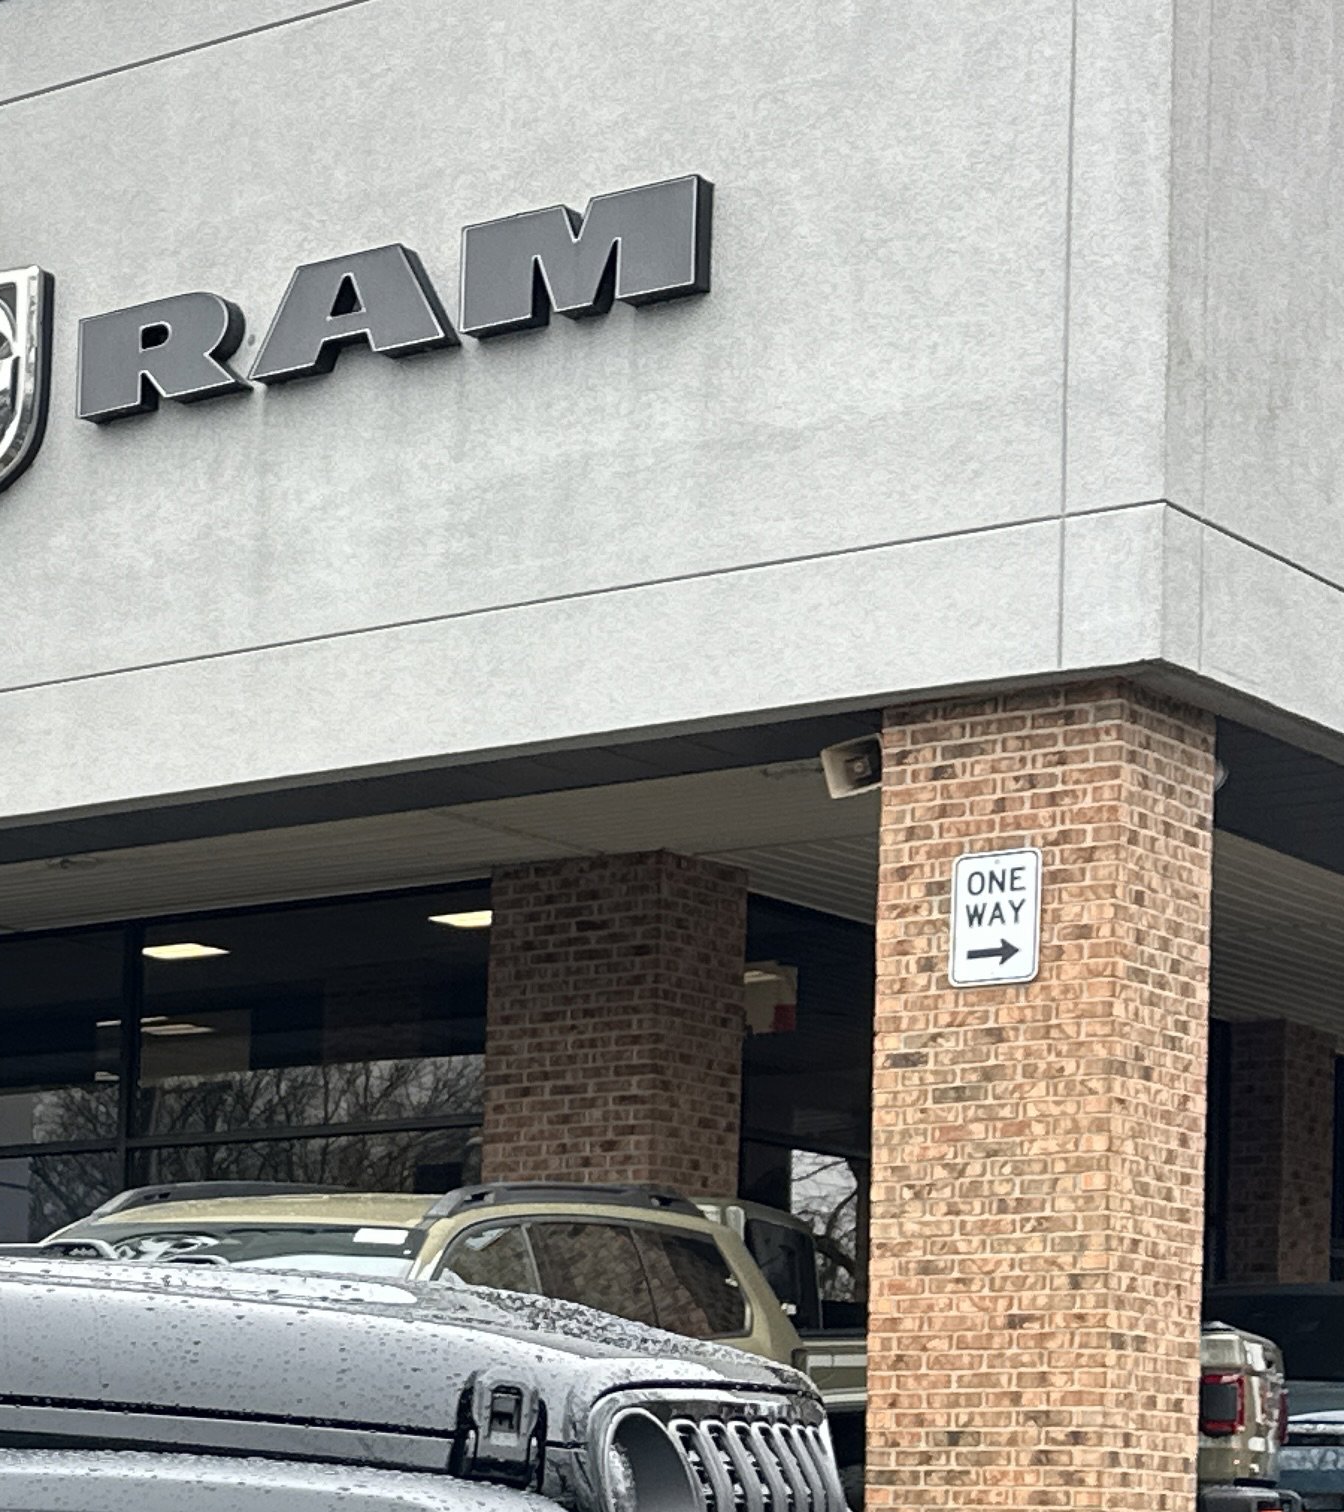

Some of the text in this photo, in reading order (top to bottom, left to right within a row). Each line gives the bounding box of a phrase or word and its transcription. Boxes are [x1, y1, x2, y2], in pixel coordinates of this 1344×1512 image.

[76, 174, 714, 426] RAM
[967, 866, 1026, 896] ONE
[965, 898, 1026, 928] WAY
